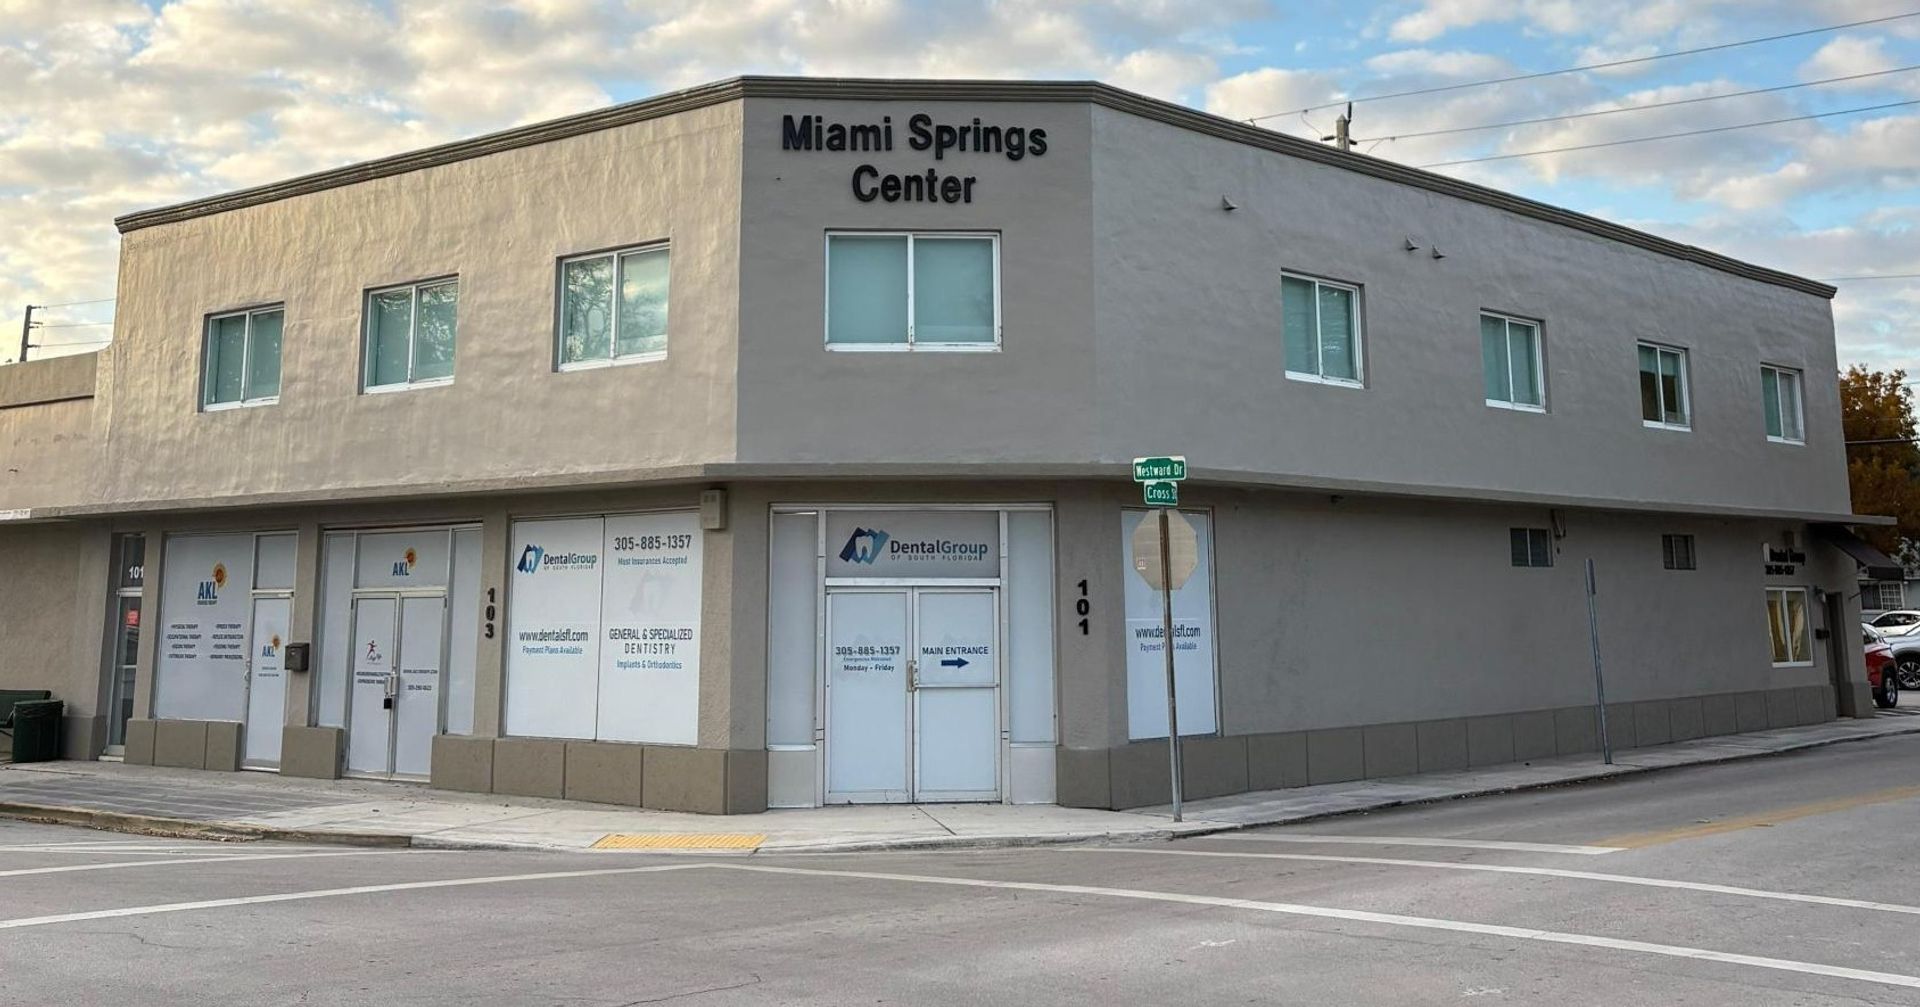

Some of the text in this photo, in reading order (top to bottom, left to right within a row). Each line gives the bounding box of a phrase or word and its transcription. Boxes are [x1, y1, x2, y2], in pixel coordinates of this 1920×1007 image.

[782, 113, 1048, 161] Miami Springs
[852, 164, 977, 204] Center
[1136, 463, 1183, 477] Westward Dr
[1147, 486, 1170, 499] Cross
[614, 534, 692, 550] 305-885-1357
[890, 539, 988, 560] DentalGroup
[544, 552, 597, 569] DentalGroup
[663, 556, 688, 566] Accepted
[129, 566, 144, 579] 101
[392, 562, 410, 576] AKL
[198, 582, 218, 599] AKL
[485, 587, 495, 639] 103
[1076, 579, 1090, 636] 101
[519, 628, 588, 641] www.dentalsfl.com
[609, 628, 694, 640] GENERAL & SPECIALIZED
[1135, 624, 1200, 638] www.dealsfl.com
[624, 643, 675, 654] DENTISTRY
[835, 646, 900, 655] 305-885-1357
[922, 646, 989, 655] MAIN ENTRANCE
[647, 660, 682, 670] Orthodontics
[843, 664, 868, 672] Monday
[875, 664, 895, 672] Friday
